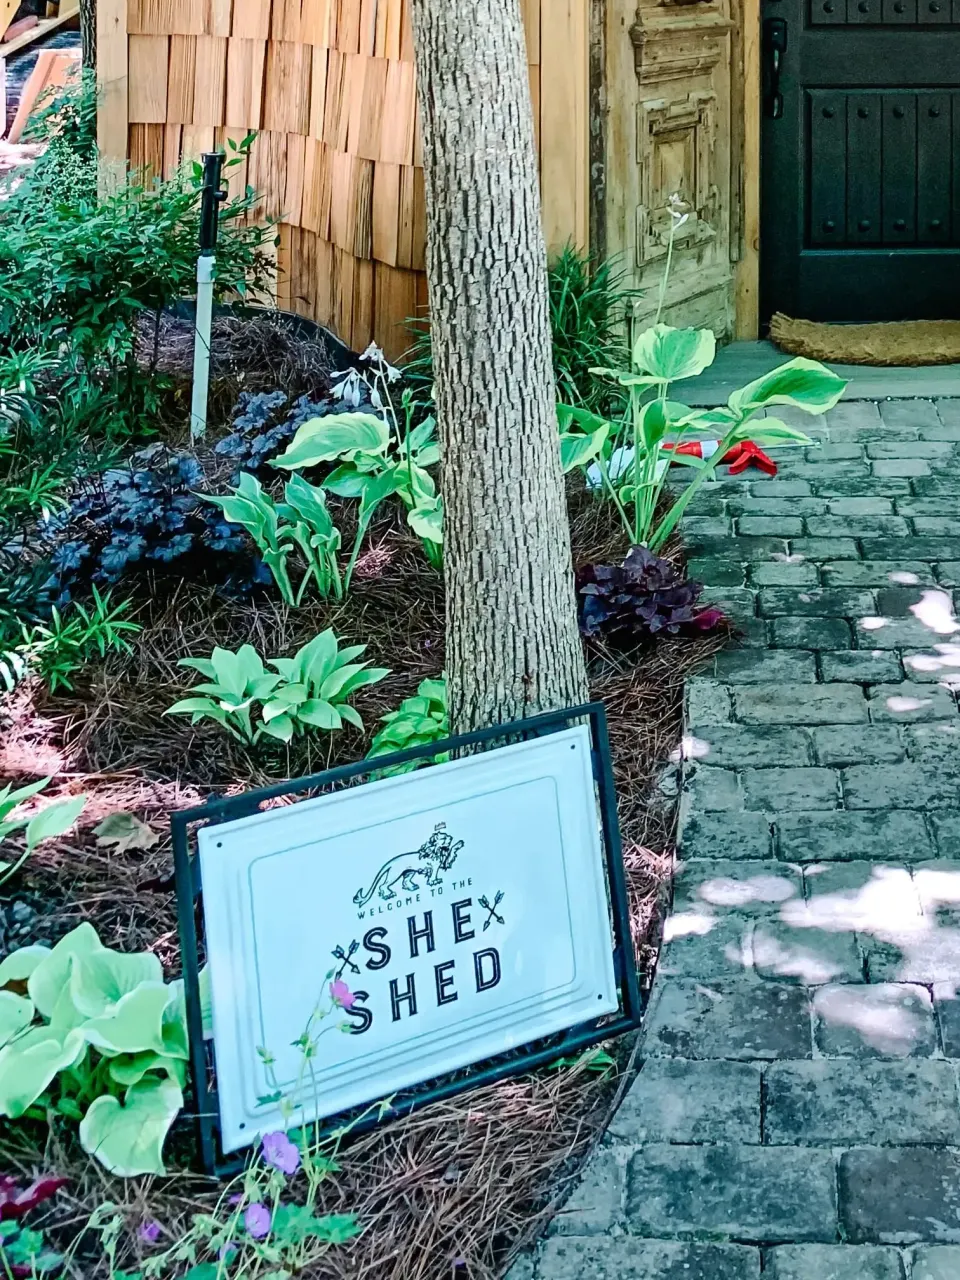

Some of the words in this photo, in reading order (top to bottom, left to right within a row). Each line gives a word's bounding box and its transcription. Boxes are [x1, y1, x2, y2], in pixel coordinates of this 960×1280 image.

[357, 894, 421, 919] WELCOME
[430, 887, 443, 898] TO
[452, 878, 473, 890] THE
[363, 898, 475, 970] SHE
[345, 947, 501, 1035] SHED
